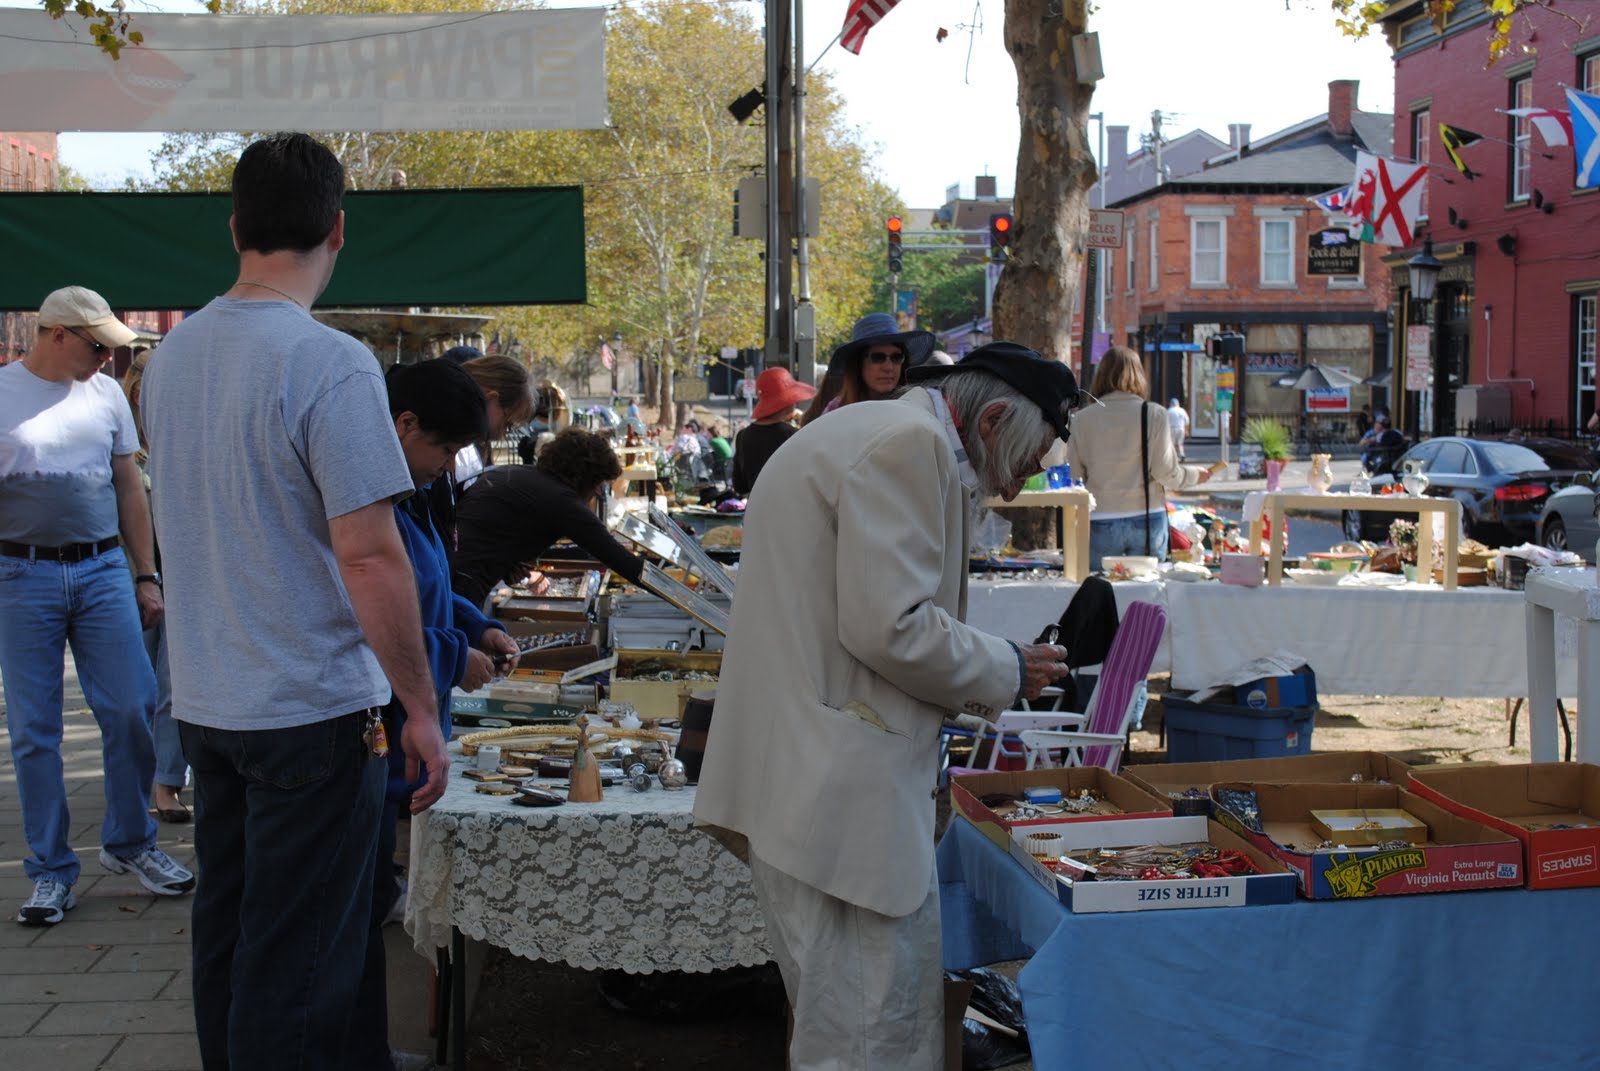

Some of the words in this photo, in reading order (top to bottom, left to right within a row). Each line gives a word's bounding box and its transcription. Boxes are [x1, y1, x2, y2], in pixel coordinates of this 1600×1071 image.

[1365, 853, 1422, 878] PLANTERS
[1454, 861, 1473, 869] Extra
[1474, 860, 1495, 869] Large
[1542, 854, 1592, 872] STAPLES
[1405, 873, 1449, 887] Virginia
[1452, 870, 1495, 882] Peanuts
[1138, 887, 1170, 900] SIZE
[1176, 885, 1229, 899] LETTER
